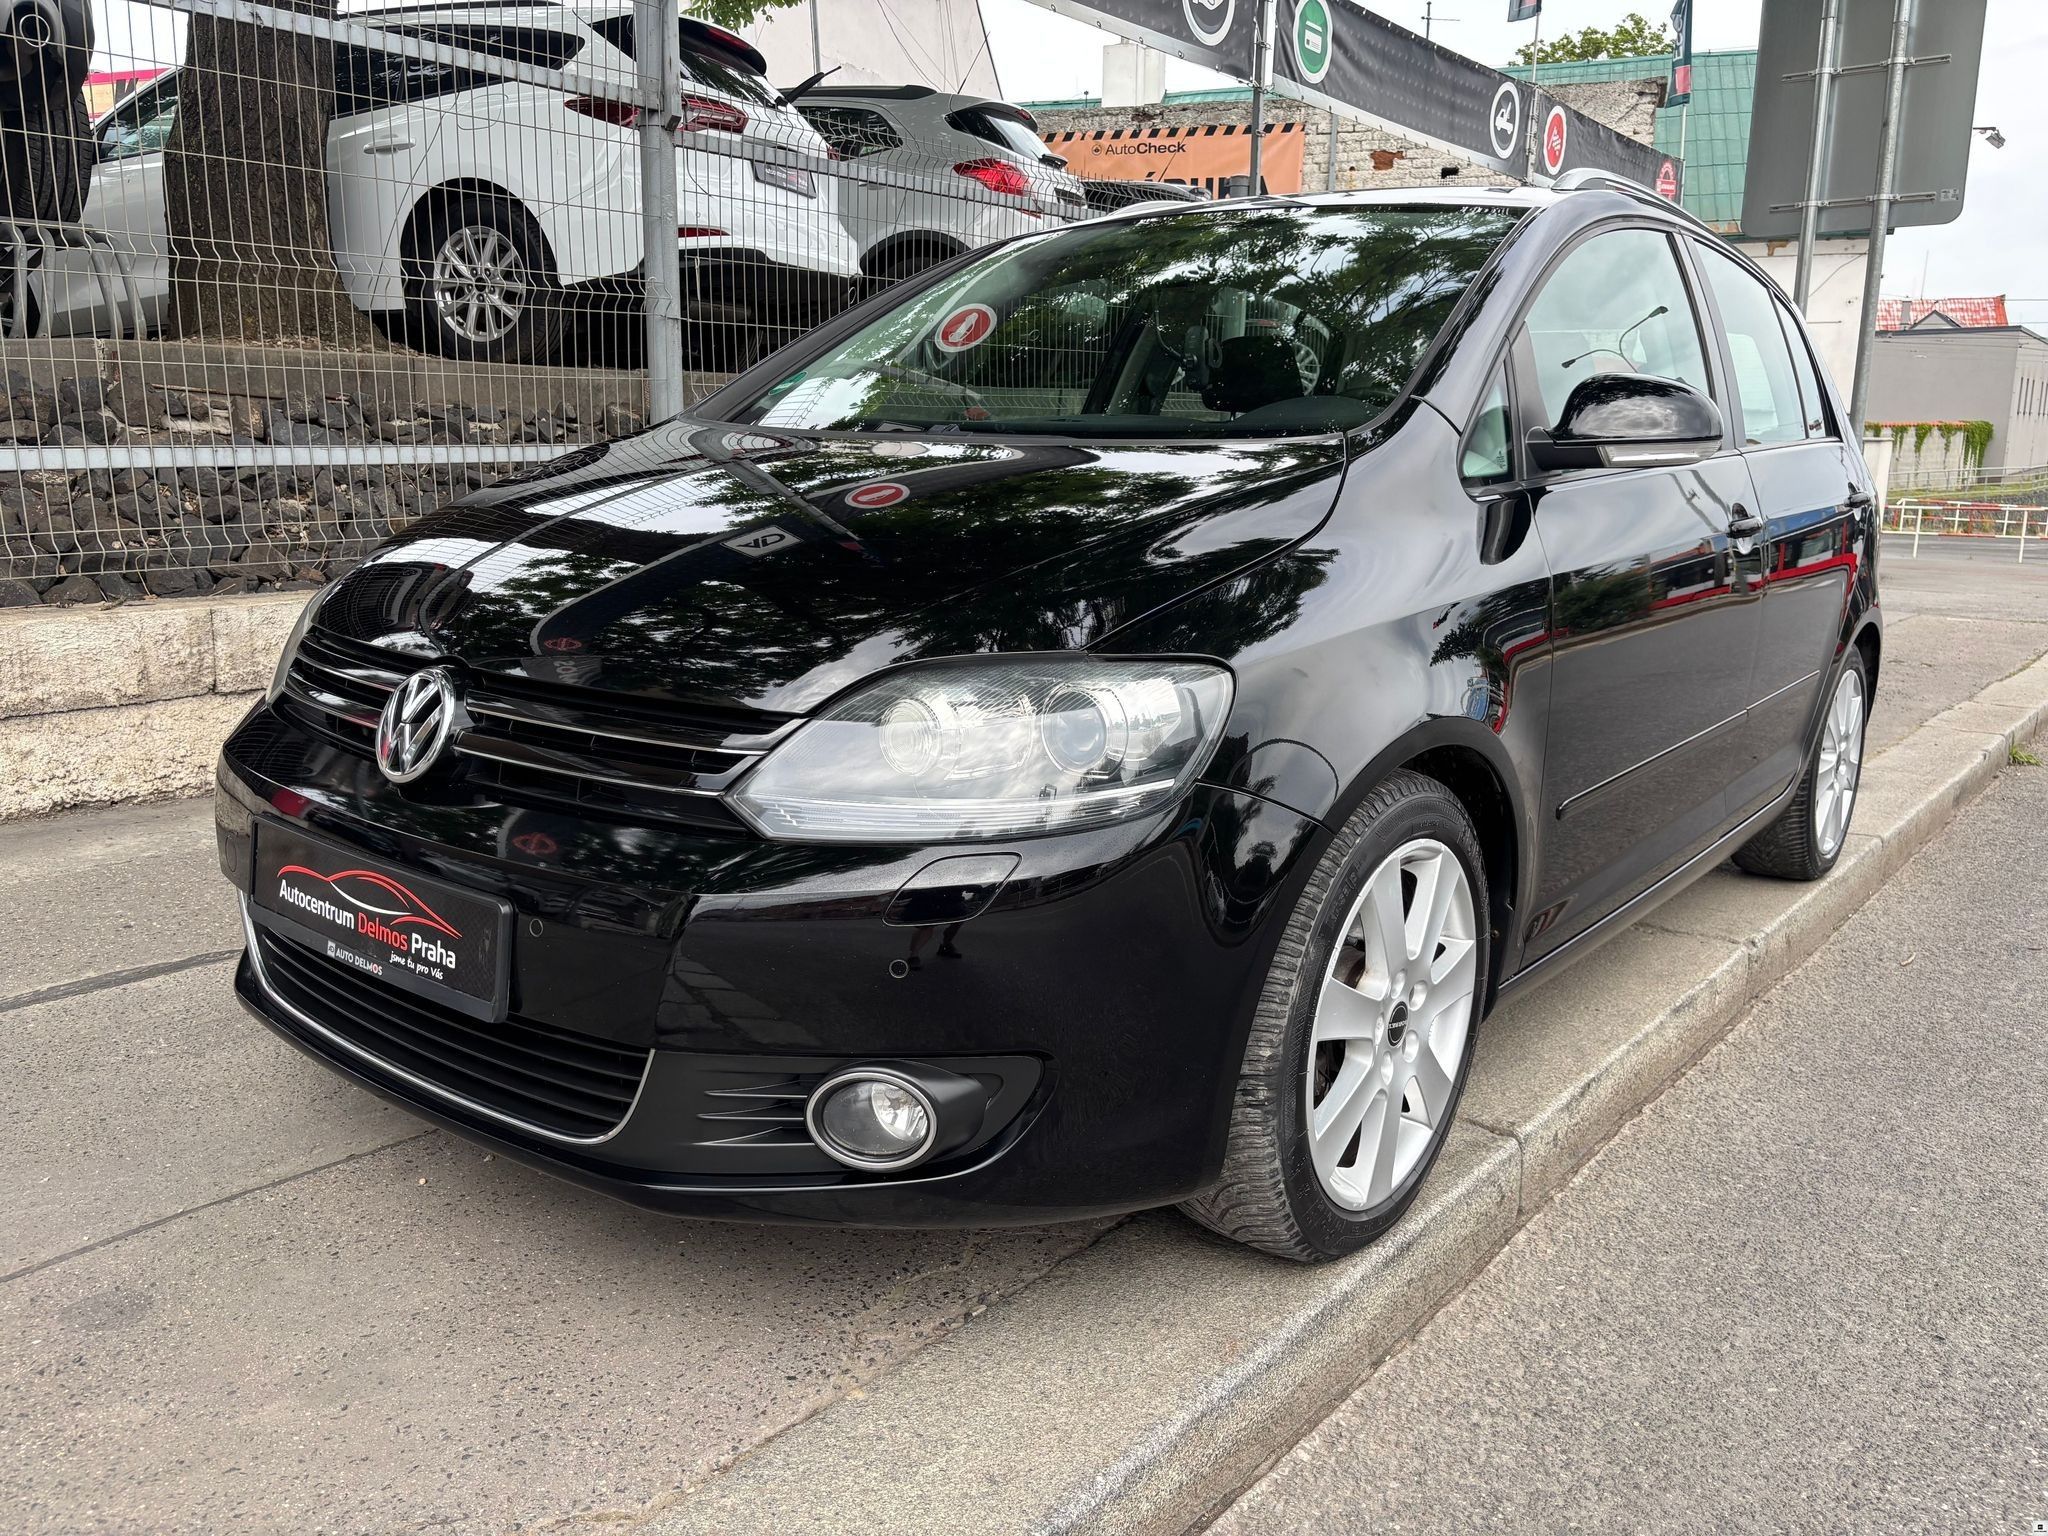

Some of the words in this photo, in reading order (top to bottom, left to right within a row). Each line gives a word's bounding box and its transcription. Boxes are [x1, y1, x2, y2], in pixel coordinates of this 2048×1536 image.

[1105, 141, 1187, 155] AutoCheck
[279, 878, 355, 930] Autocentrum
[357, 911, 408, 951] Delmos
[411, 932, 456, 969] Praha
[335, 948, 354, 963] AUTO
[354, 955, 383, 976] DELMOS
[389, 950, 406, 966] jsme
[407, 957, 415, 970] tu
[416, 963, 429, 975] pro
[430, 966, 444, 980] Vás
